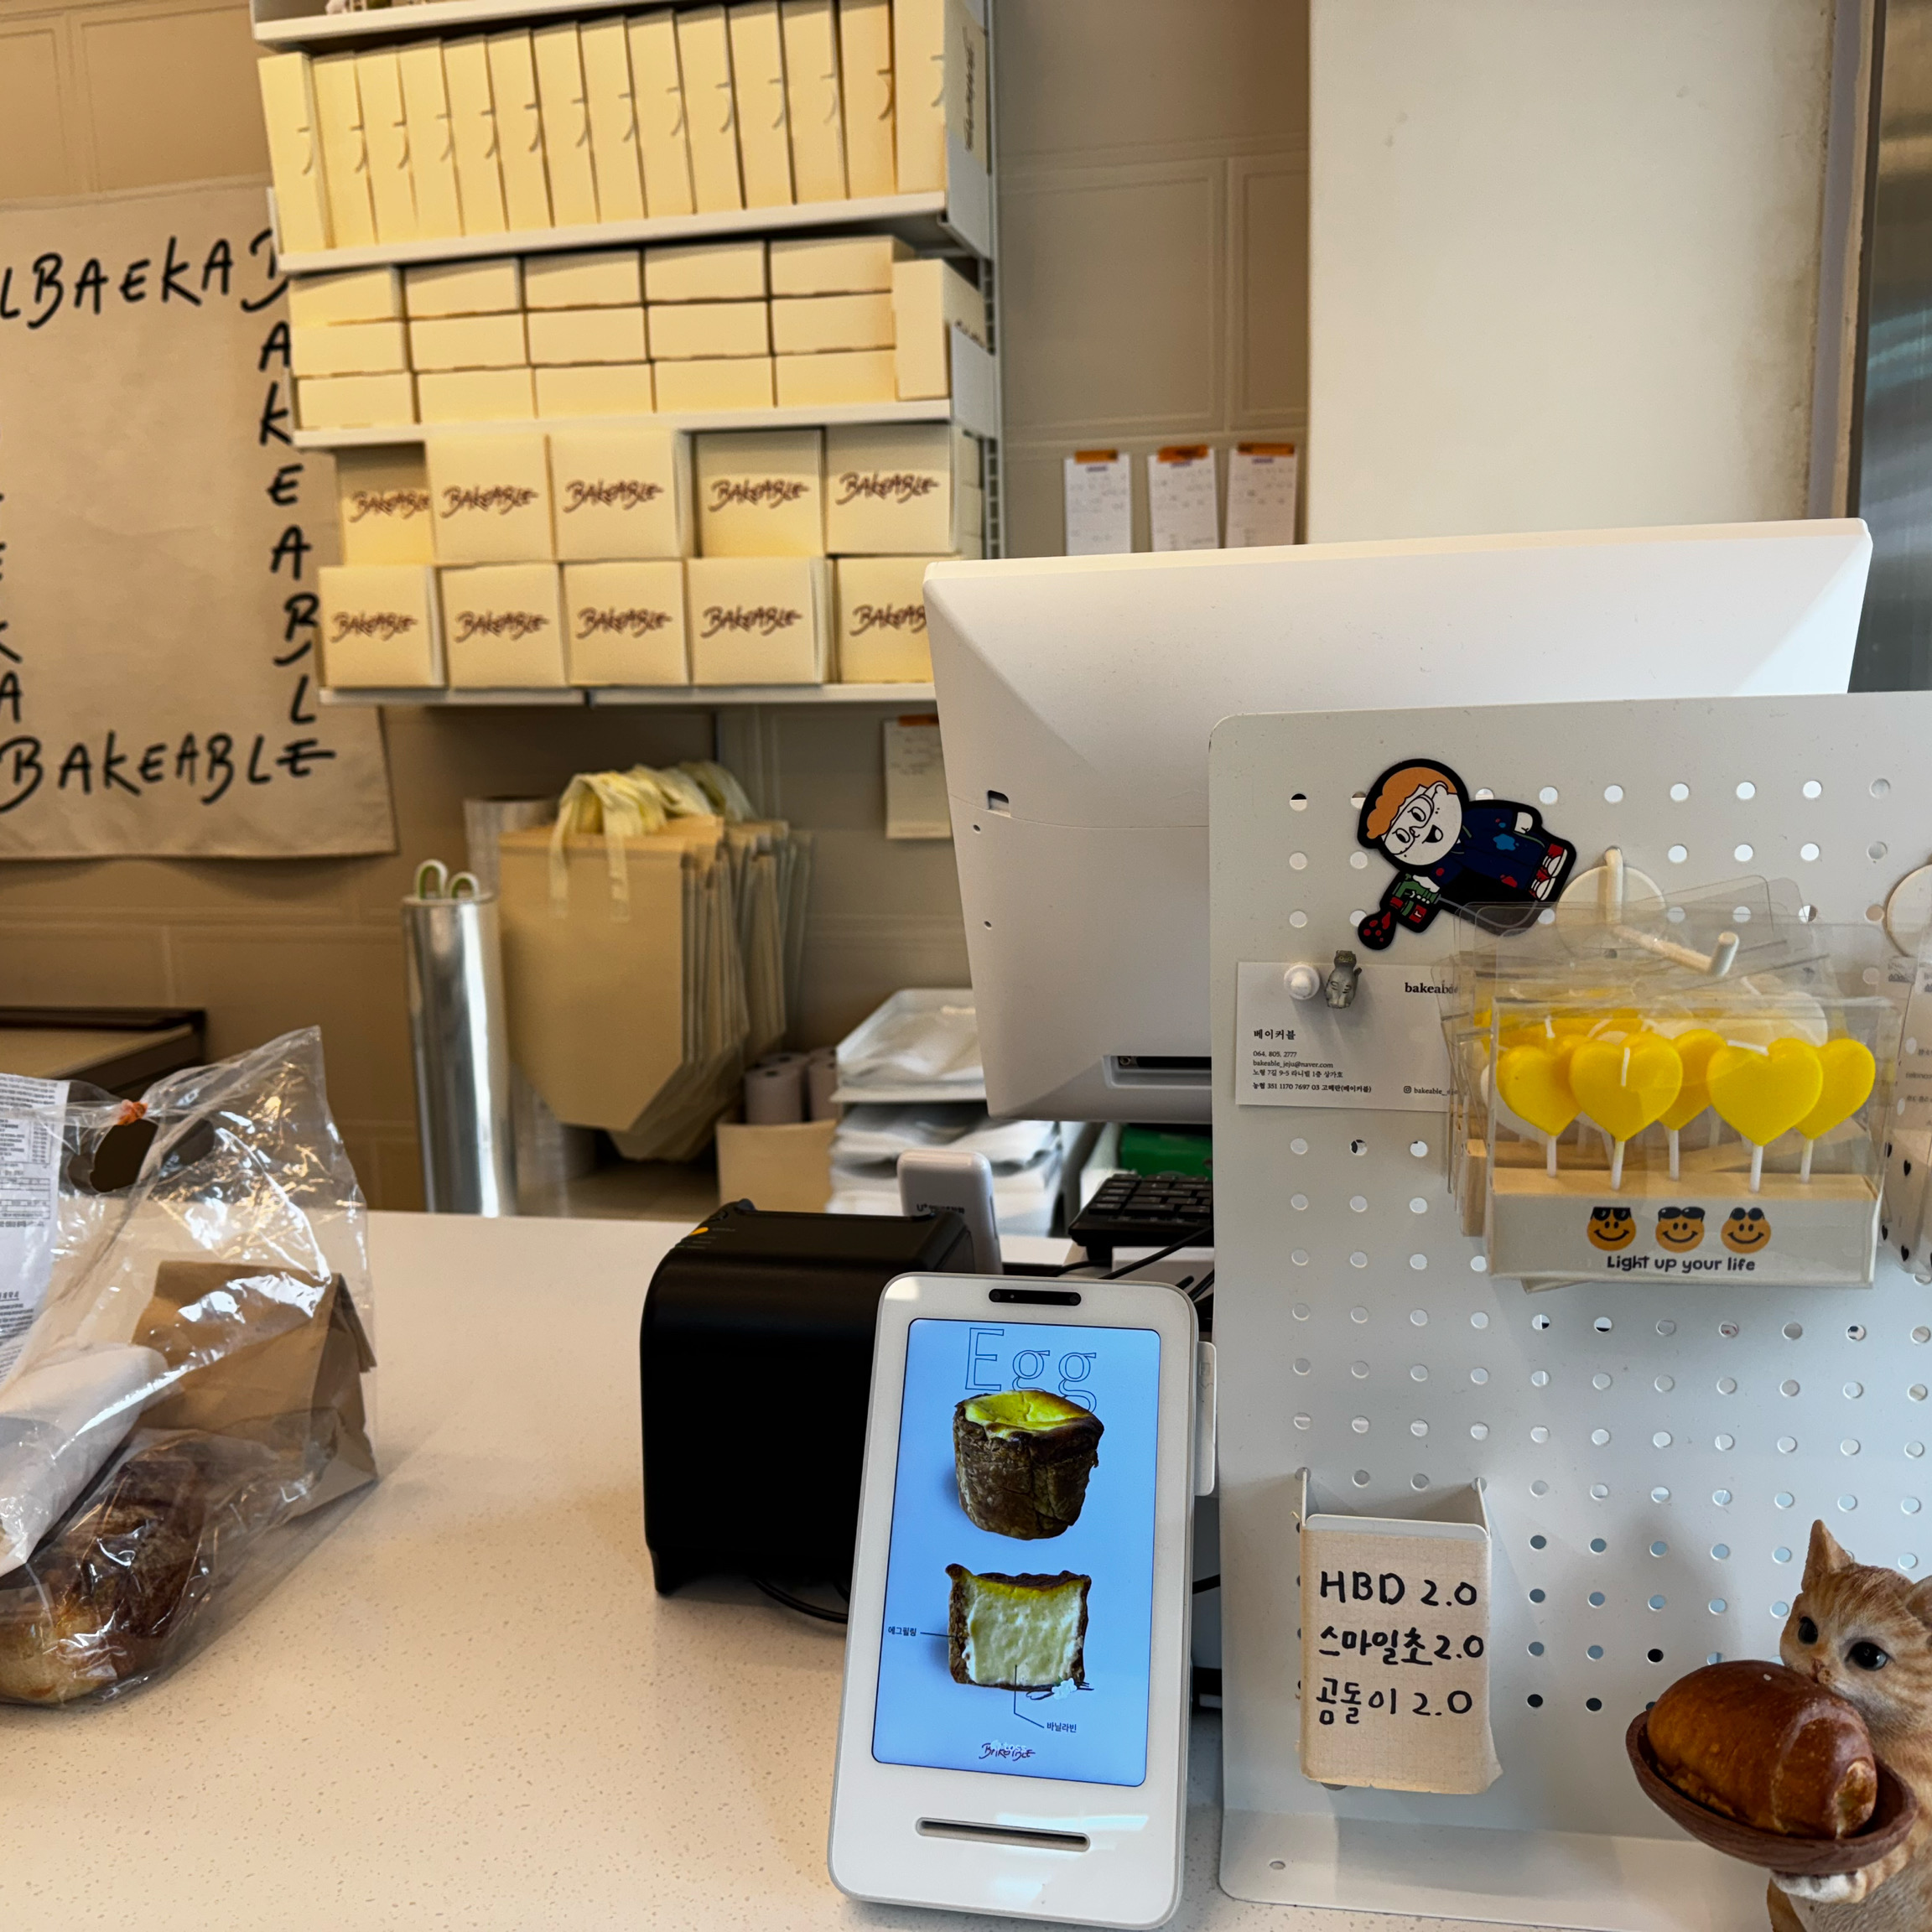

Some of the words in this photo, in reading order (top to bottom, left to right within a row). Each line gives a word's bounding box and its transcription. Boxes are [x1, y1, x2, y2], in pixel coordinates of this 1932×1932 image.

[849, 603, 927, 636] BAKEAB
[0, 730, 336, 814] BAKEABLE
[1254, 1029, 1296, 1040] 베이커블
[1253, 1060, 1333, 1068] bakeable_jeju@naver.com
[1607, 1255, 1649, 1271] Light
[1654, 1259, 1677, 1272] up
[1682, 1259, 1722, 1273] your
[1727, 1257, 1755, 1271] life
[965, 1327, 1097, 1413] Egg
[1320, 1571, 1405, 1605] HBD
[1420, 1579, 1478, 1607] 2.0
[888, 1626, 917, 1637] 에그필링
[1316, 1677, 1396, 1725] 곰돌이
[1412, 1690, 1472, 1716] 2.0
[1046, 1722, 1077, 1732] 바닐라빈
